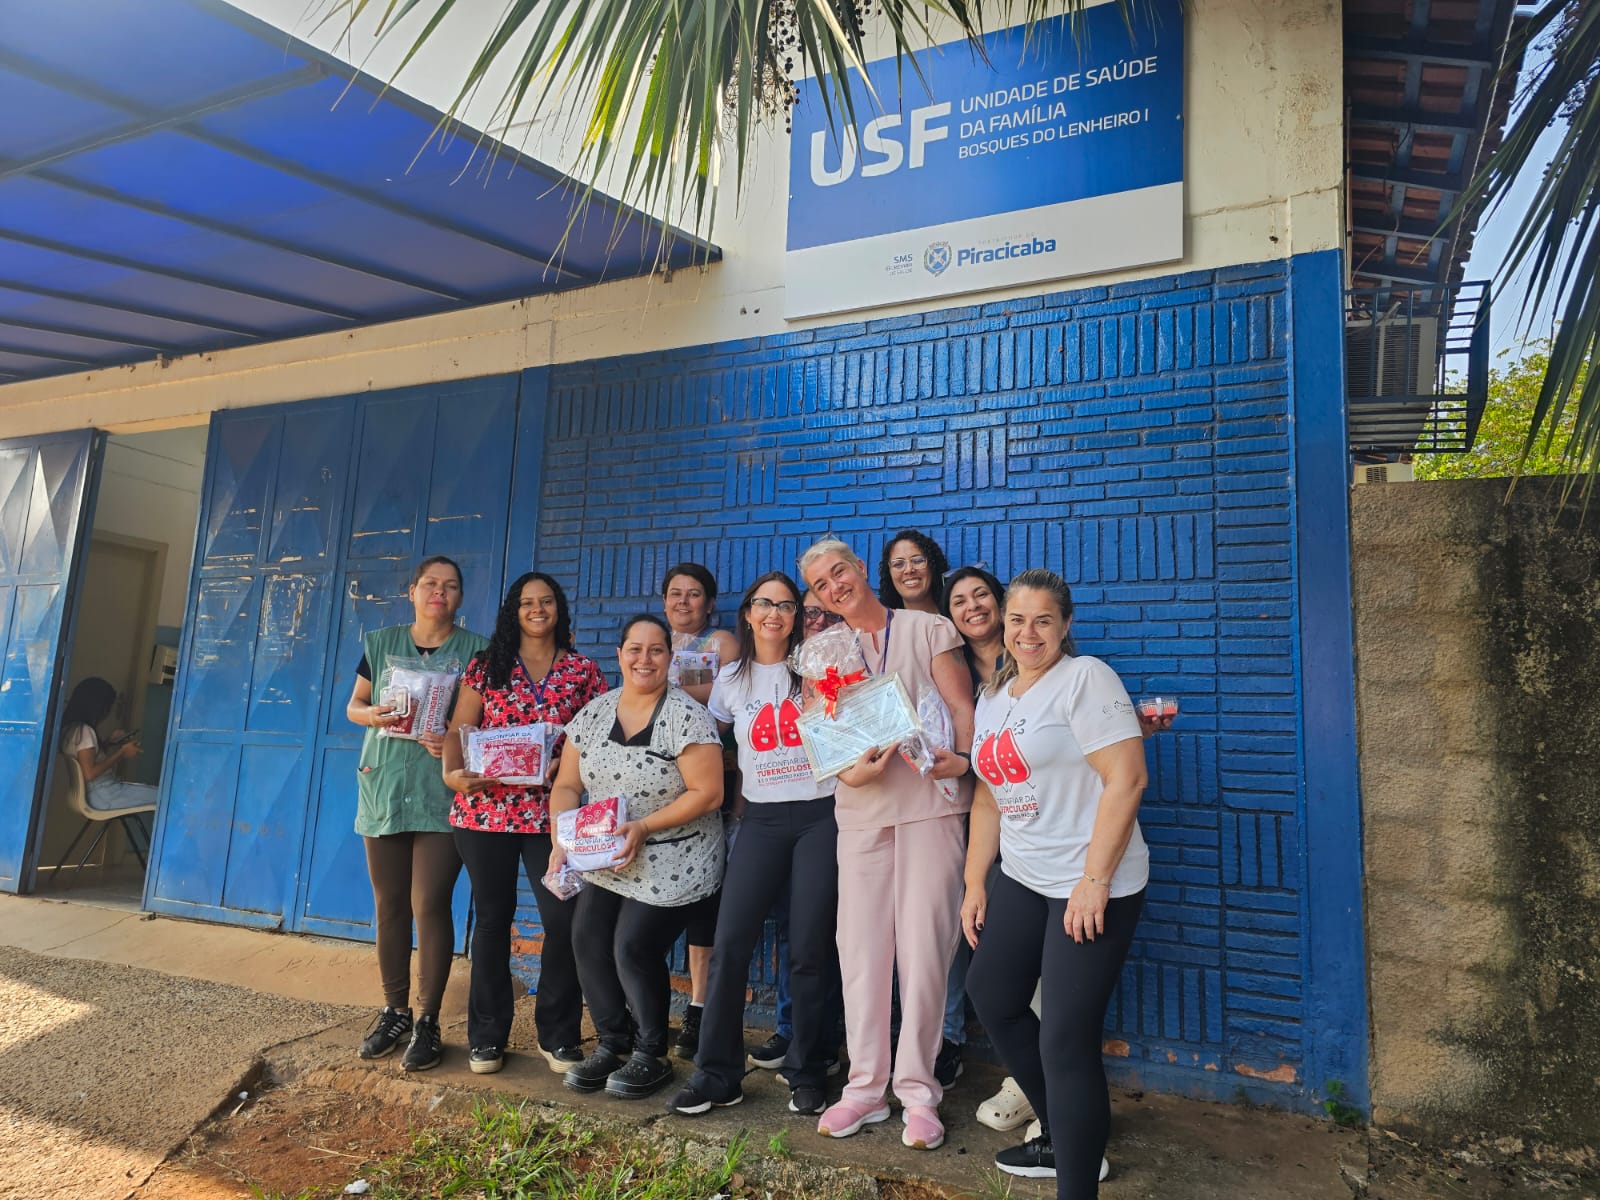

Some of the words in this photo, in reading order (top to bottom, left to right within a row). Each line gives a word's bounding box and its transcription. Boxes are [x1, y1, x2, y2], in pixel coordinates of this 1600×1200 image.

[961, 80, 1049, 114] UNIDADE
[1053, 73, 1081, 94] DE
[1085, 56, 1158, 87] SAÚDE
[958, 133, 1029, 159] BOSQUES
[1032, 127, 1056, 145] DO
[1059, 110, 1141, 139] LENHEIRO
[1144, 108, 1149, 122] I
[960, 119, 986, 139] DA
[989, 102, 1067, 133] FAMÍLIA
[810, 101, 951, 187] USF
[893, 253, 913, 264] SMS
[957, 237, 1057, 267] Piracicaba
[425, 685, 439, 734] TUBERCULO
[755, 757, 799, 771] DESCONFIAR
[756, 763, 812, 778] TUBERCULOSE
[567, 842, 617, 853] BERCULOSE
